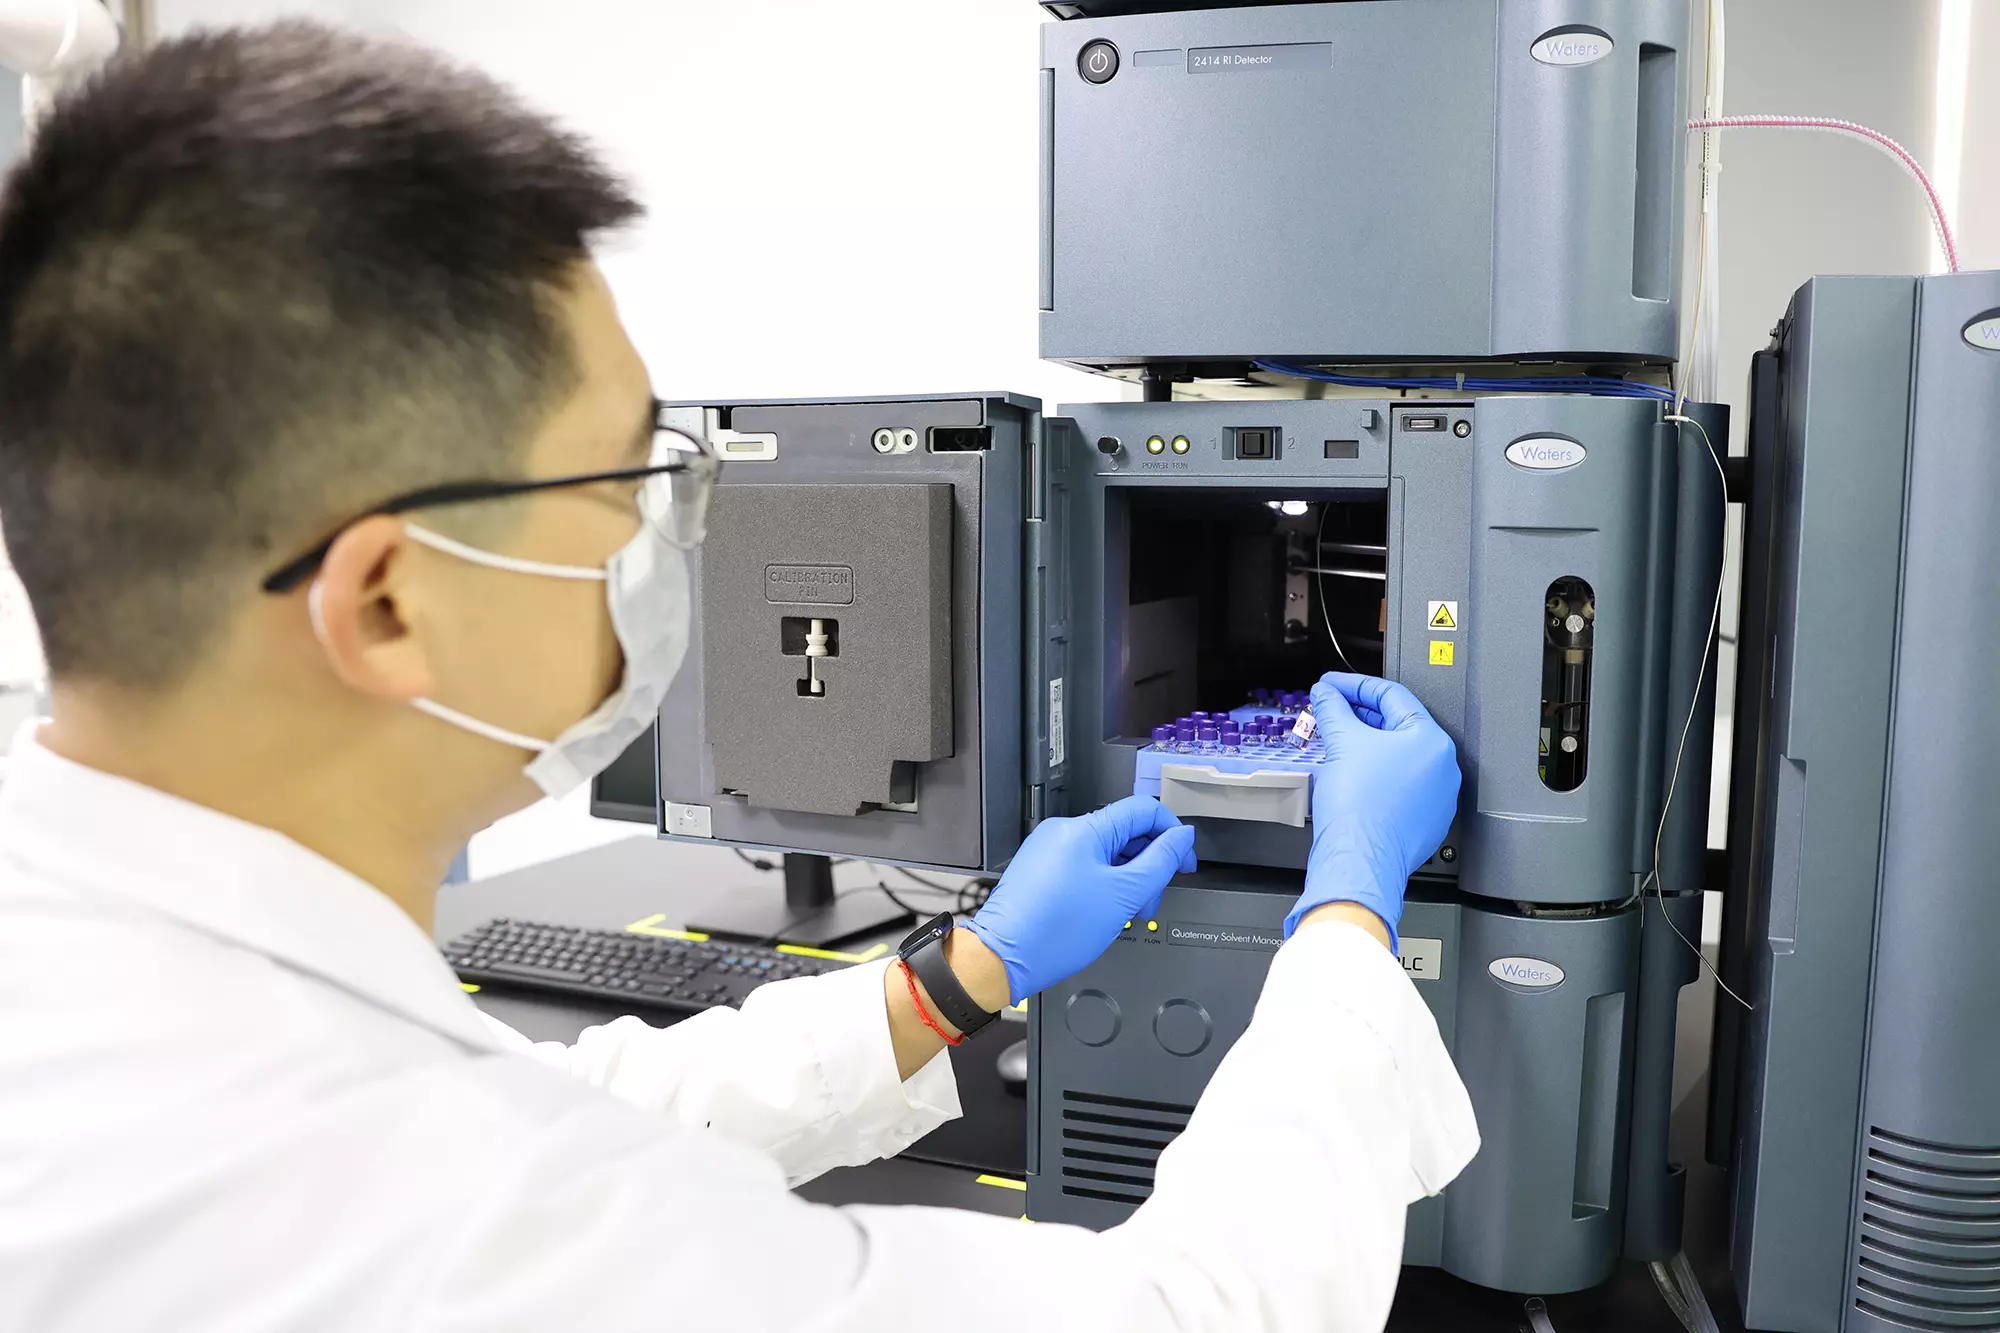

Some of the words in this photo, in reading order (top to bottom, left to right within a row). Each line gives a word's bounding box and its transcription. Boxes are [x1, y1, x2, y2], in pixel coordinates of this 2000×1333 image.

[1544, 41, 1599, 57] Waters
[1194, 55, 1220, 67] 2414
[1222, 55, 1232, 65] RI
[1234, 54, 1273, 65] Detector
[1287, 437, 1296, 450] 2
[1520, 446, 1572, 461] Waters
[770, 572, 848, 584] CALIBRATION
[1171, 928, 1219, 943] Quaternary
[1221, 932, 1251, 943] Solvent
[1502, 963, 1551, 981] Waters
